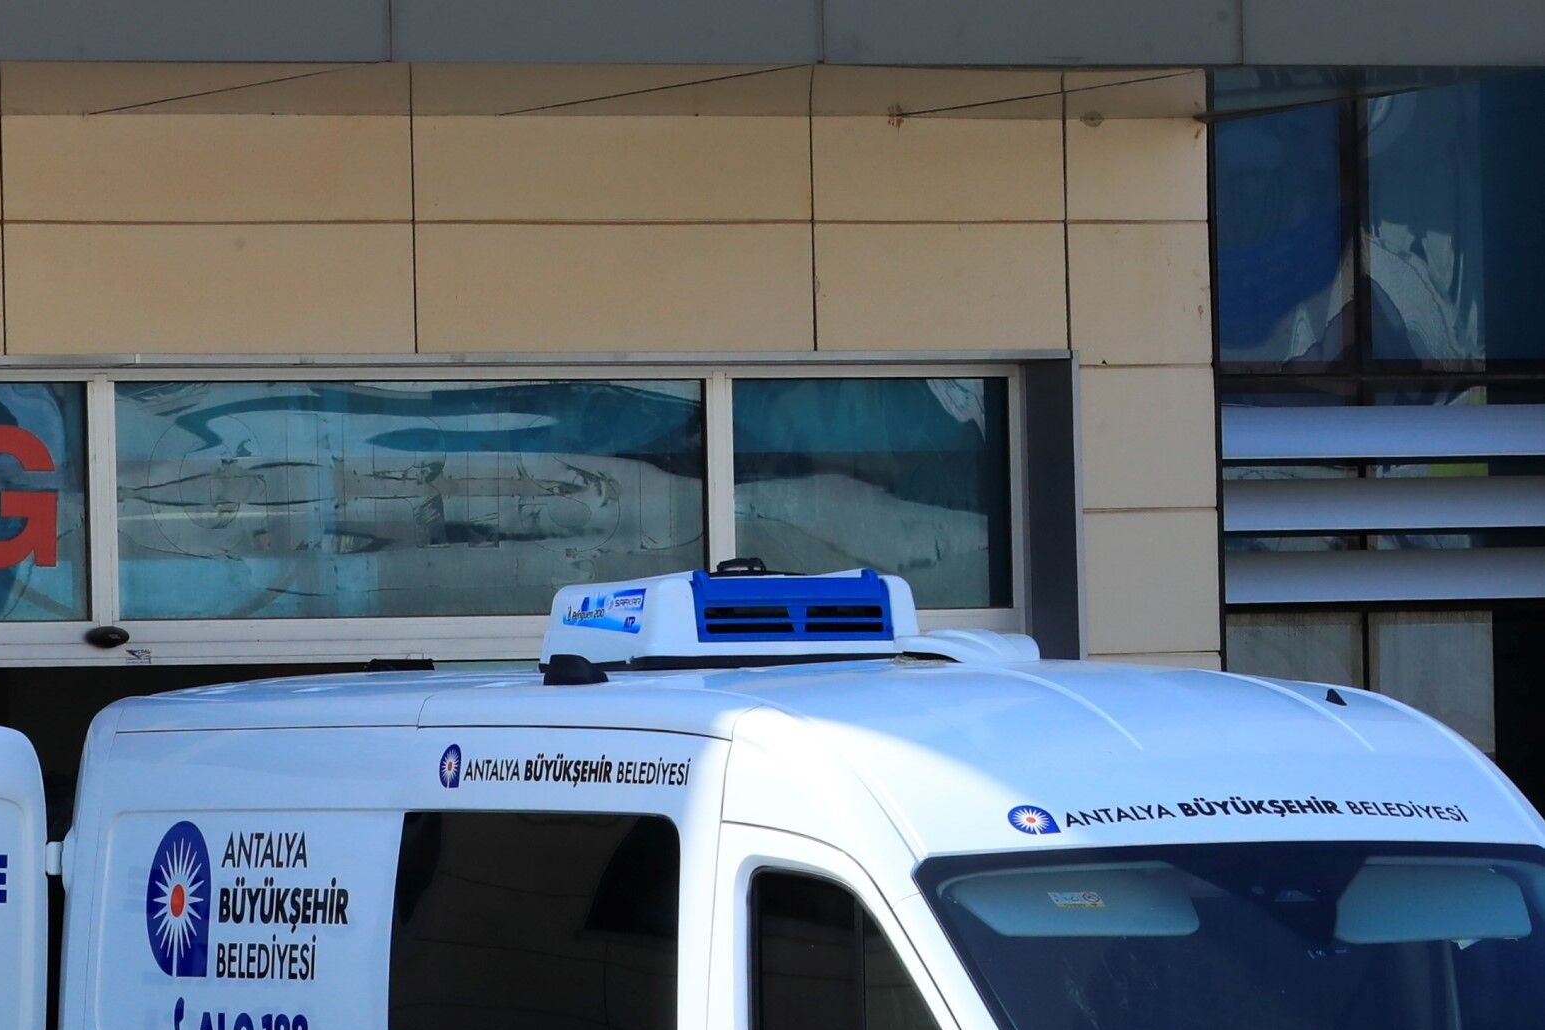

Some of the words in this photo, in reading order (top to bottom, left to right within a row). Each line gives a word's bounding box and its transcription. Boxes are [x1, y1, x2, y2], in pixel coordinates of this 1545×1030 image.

[464, 759, 520, 782] ANTALYA
[523, 753, 612, 788] BÜYÜKŞEHİR
[616, 757, 691, 786] BELEDİYESİ
[1065, 803, 1176, 828] ANTALYA
[1177, 796, 1343, 818] BÜYÜKŞEHİR
[1344, 800, 1469, 824] BELEDİYESİ
[221, 831, 309, 869] ANTALYA
[218, 877, 350, 933] BÜYÜKŞEHİR
[215, 933, 316, 982] BELEDİYESİ
